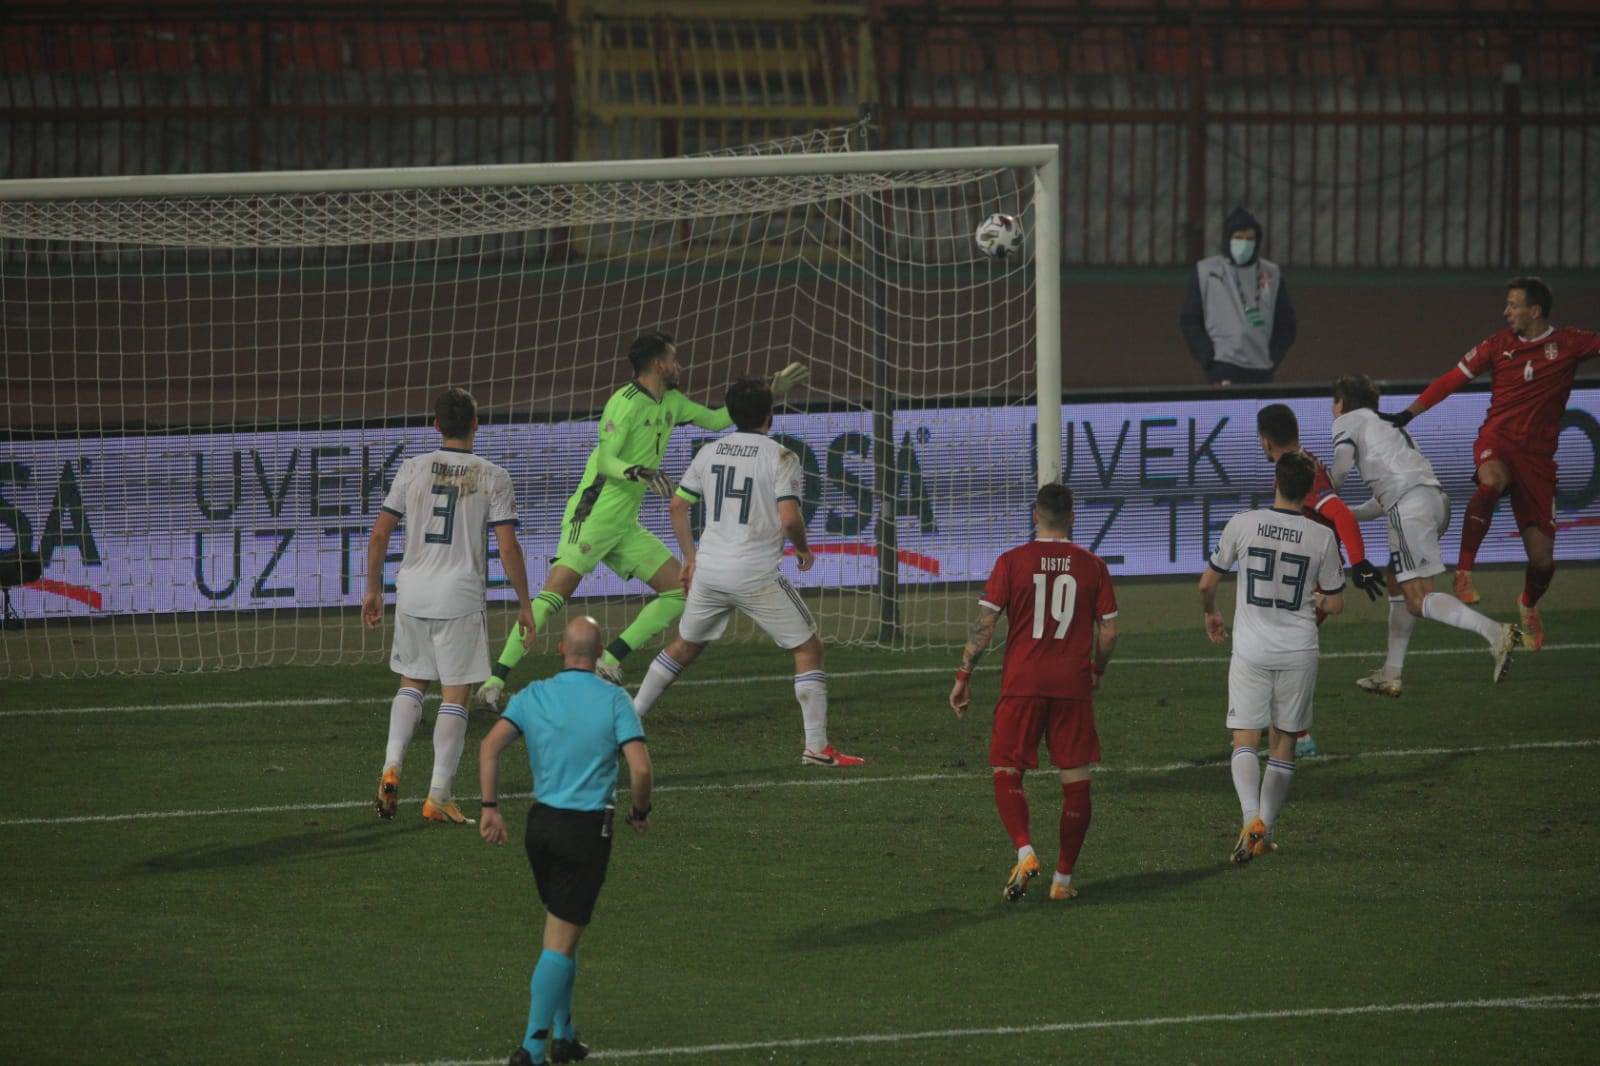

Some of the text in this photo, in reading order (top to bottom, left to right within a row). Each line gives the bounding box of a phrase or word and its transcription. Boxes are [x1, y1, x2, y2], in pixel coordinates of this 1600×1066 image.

[1523, 359, 1534, 382] 6
[195, 443, 404, 520] UVEK
[424, 484, 459, 545] 3
[711, 464, 753, 525] 14
[195, 528, 296, 601] UZ
[1246, 546, 1311, 612] 23
[1031, 573, 1078, 640] 19
